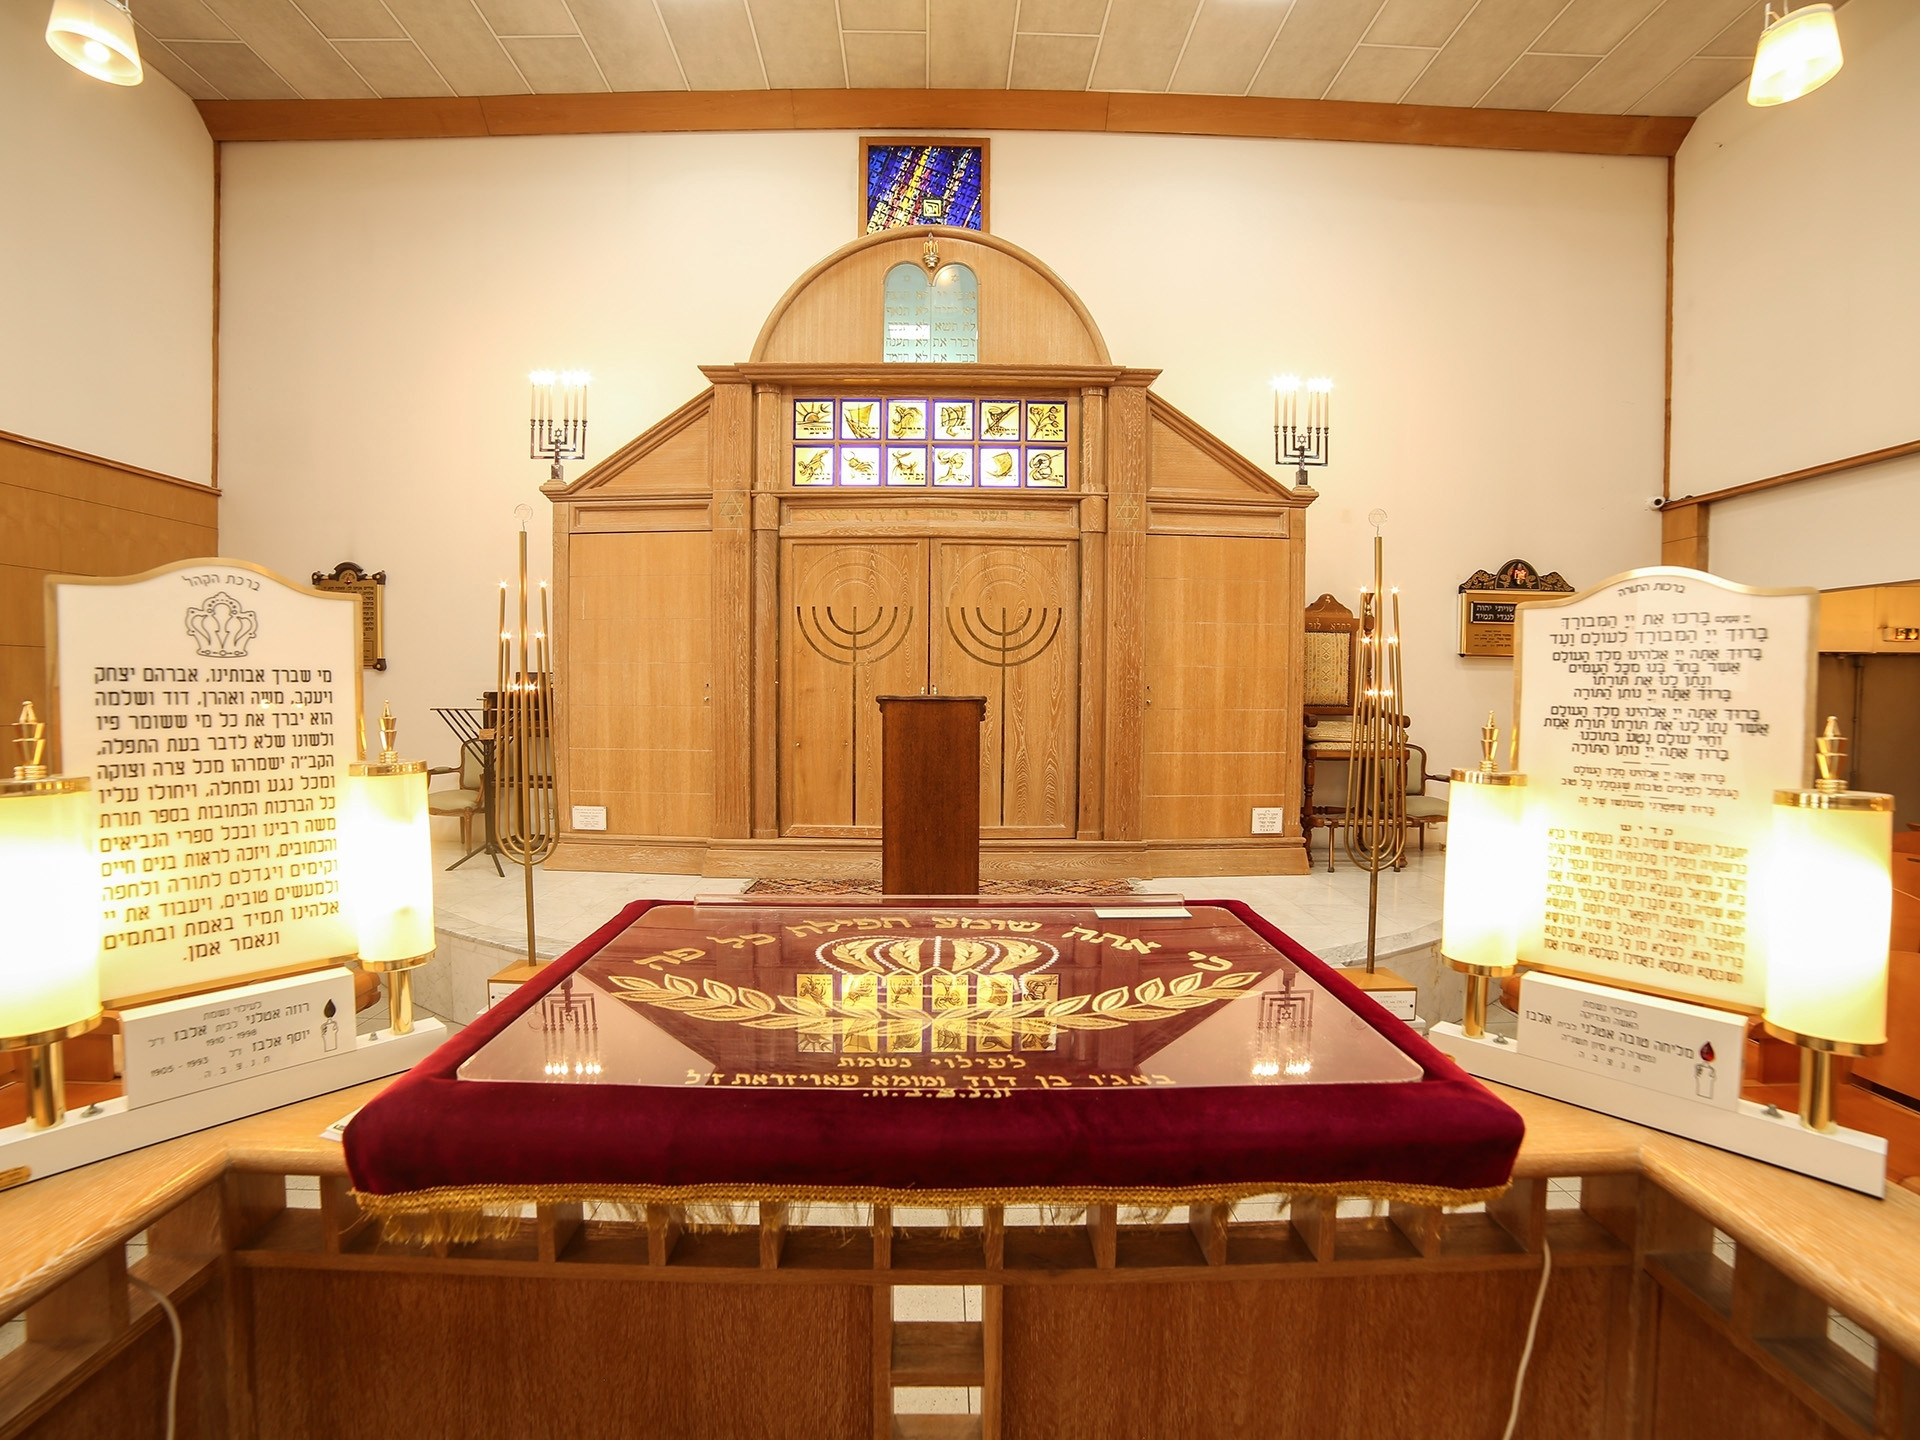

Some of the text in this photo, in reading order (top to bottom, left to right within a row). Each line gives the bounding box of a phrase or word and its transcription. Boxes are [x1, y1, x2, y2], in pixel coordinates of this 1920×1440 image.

[934, 322, 958, 331] תשא
[886, 338, 928, 347] לא תענה
[933, 338, 975, 347] זכור את
[915, 350, 928, 362] לא
[933, 353, 975, 362] כבד את
[182, 574, 261, 591] ברכת הקהל
[1617, 582, 1685, 597] ברכות התורה
[94, 667, 134, 684] יצחק
[143, 668, 197, 682] אברהם
[271, 669, 310, 684] שברך
[317, 670, 331, 682] מי
[95, 689, 153, 705] ושלמה
[162, 691, 188, 704] דוד
[251, 691, 283, 704] משה
[96, 712, 332, 730] הוא יברך את כל מי ששומר פיו
[166, 737, 199, 752] בעת
[207, 734, 246, 750] לדבר
[253, 733, 285, 748] שלא
[292, 732, 333, 747] ולשונו
[97, 763, 144, 781] וצוקה
[153, 761, 184, 776] צרה
[192, 758, 223, 774] מכל
[231, 756, 284, 772] ישמרהו
[267, 778, 293, 792] נגע
[300, 775, 334, 790] ומכל
[98, 786, 138, 803] עליו
[147, 784, 196, 800] ויחולו
[99, 795, 335, 828] כל הברכות הכתובות בספר תורת
[99, 817, 336, 852] משה רבינו ובכל ספרי הנביאים
[184, 848, 229, 867] לראות
[236, 845, 269, 861] ויזכה
[142, 855, 176, 872] בנים
[168, 872, 220, 892] לתורה
[229, 865, 282, 885] ויגדלם
[124, 905, 149, 923] את
[158, 897, 212, 916] ויעבוד
[103, 900, 339, 950] אלהינו תמיד באמת ובתמים
[786, 916, 912, 937] תפילת
[932, 917, 1043, 932] שומע
[229, 931, 279, 950] ונאמר
[706, 933, 777, 949] כל
[1062, 926, 1162, 955] אתה
[285, 1002, 309, 1016] רוזה
[1526, 1010, 1551, 1024] אלבז
[174, 1025, 206, 1041] אלבז
[286, 1029, 309, 1045] יוסף
[252, 1036, 281, 1051] אלבז
[837, 1054, 1027, 1069] לעילוי נשמת
[963, 1075, 1017, 1087] דוד
[1035, 1075, 1072, 1088] בן
